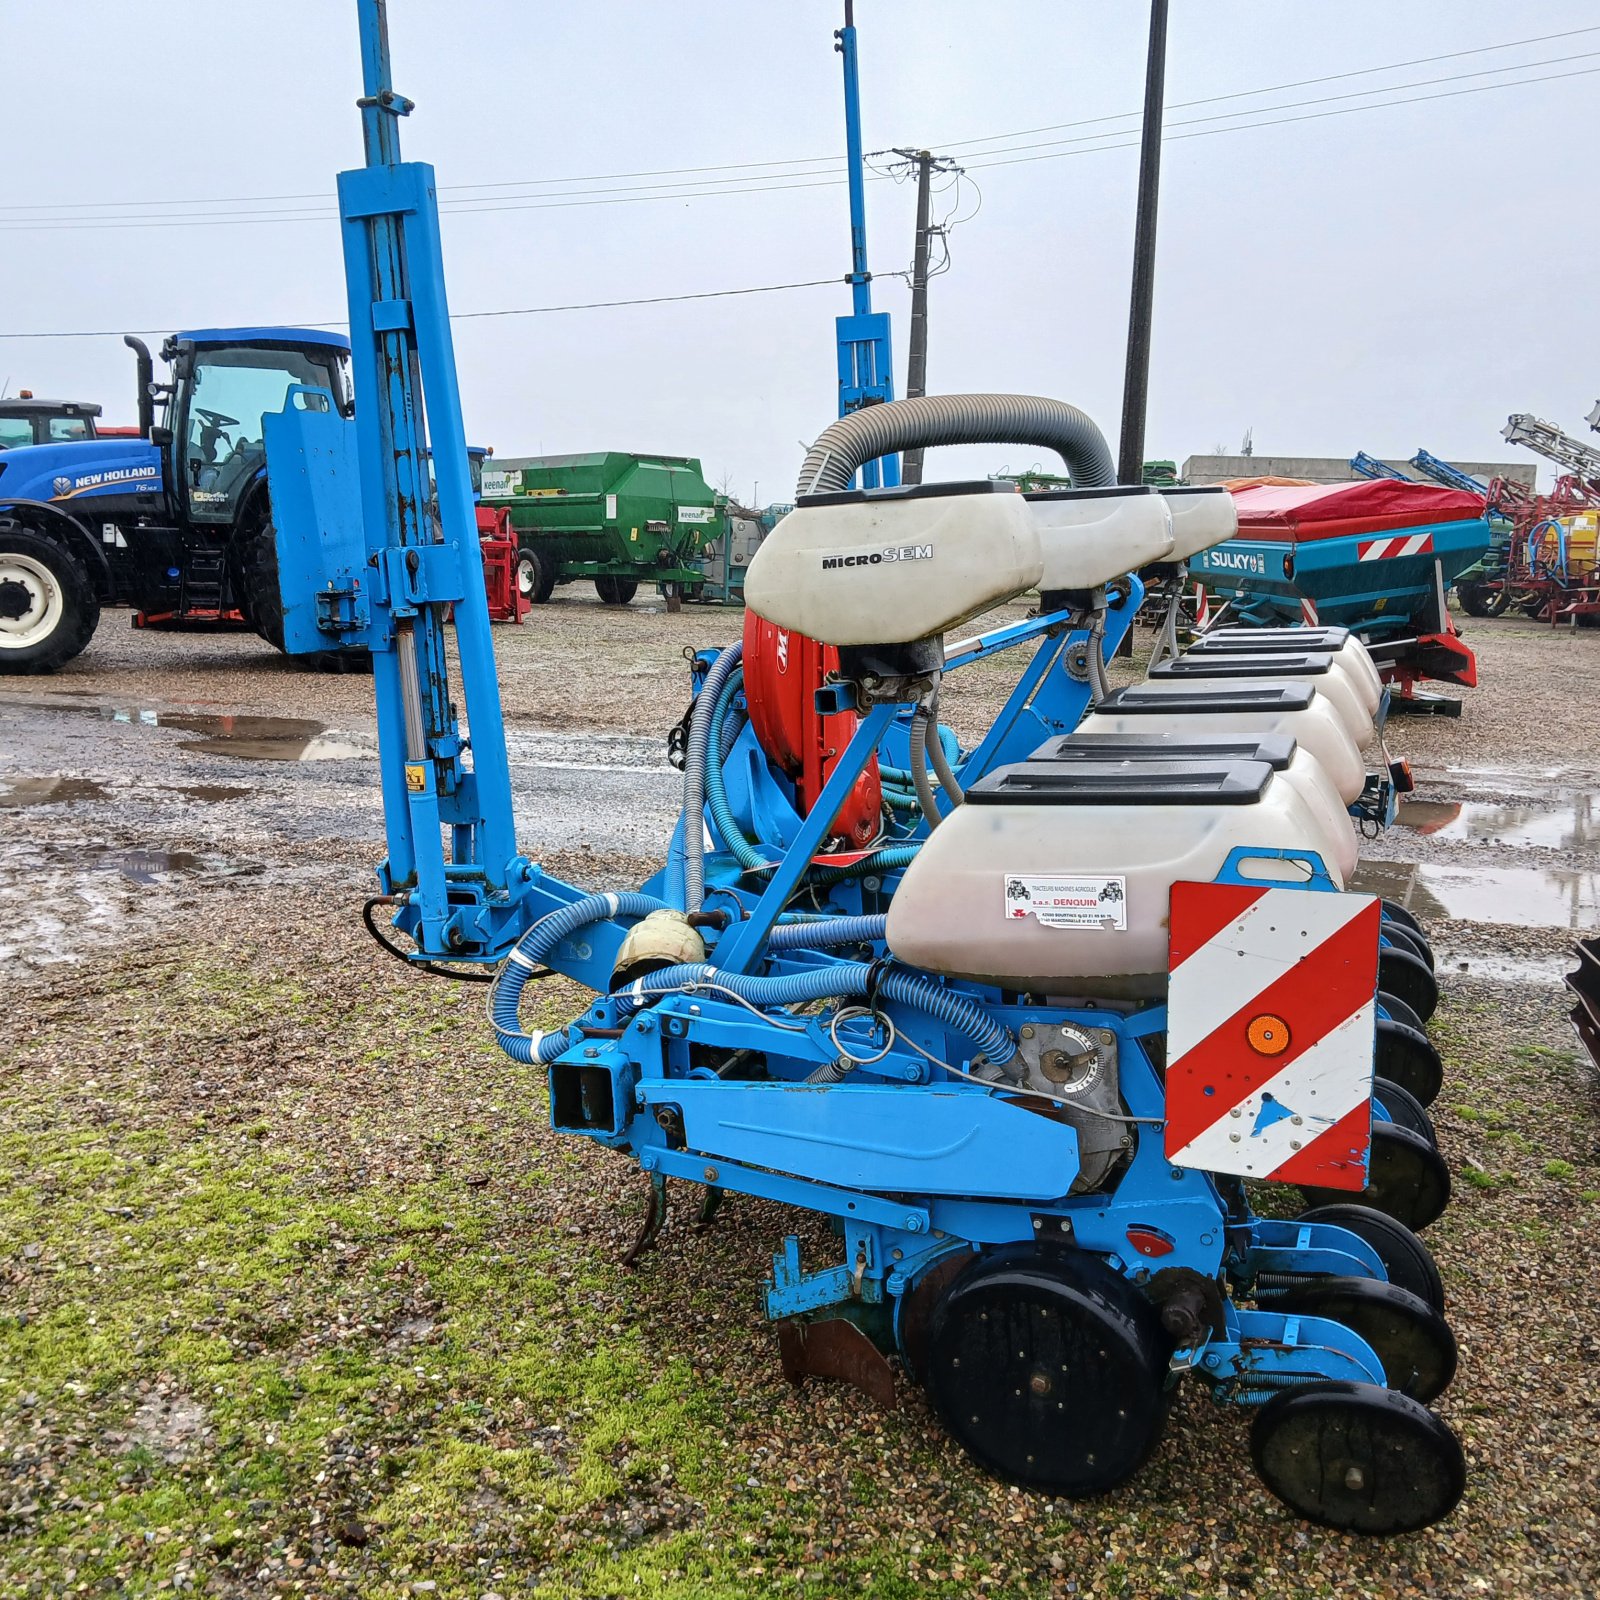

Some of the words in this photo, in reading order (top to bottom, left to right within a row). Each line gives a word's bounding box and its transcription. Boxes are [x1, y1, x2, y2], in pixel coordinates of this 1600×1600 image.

[75, 474, 102, 488] NEW
[104, 467, 156, 482] HOLLAND
[822, 544, 933, 570] MICROSEM
[1211, 551, 1249, 570] SULKY
[1053, 898, 1097, 907] DENQUIN
